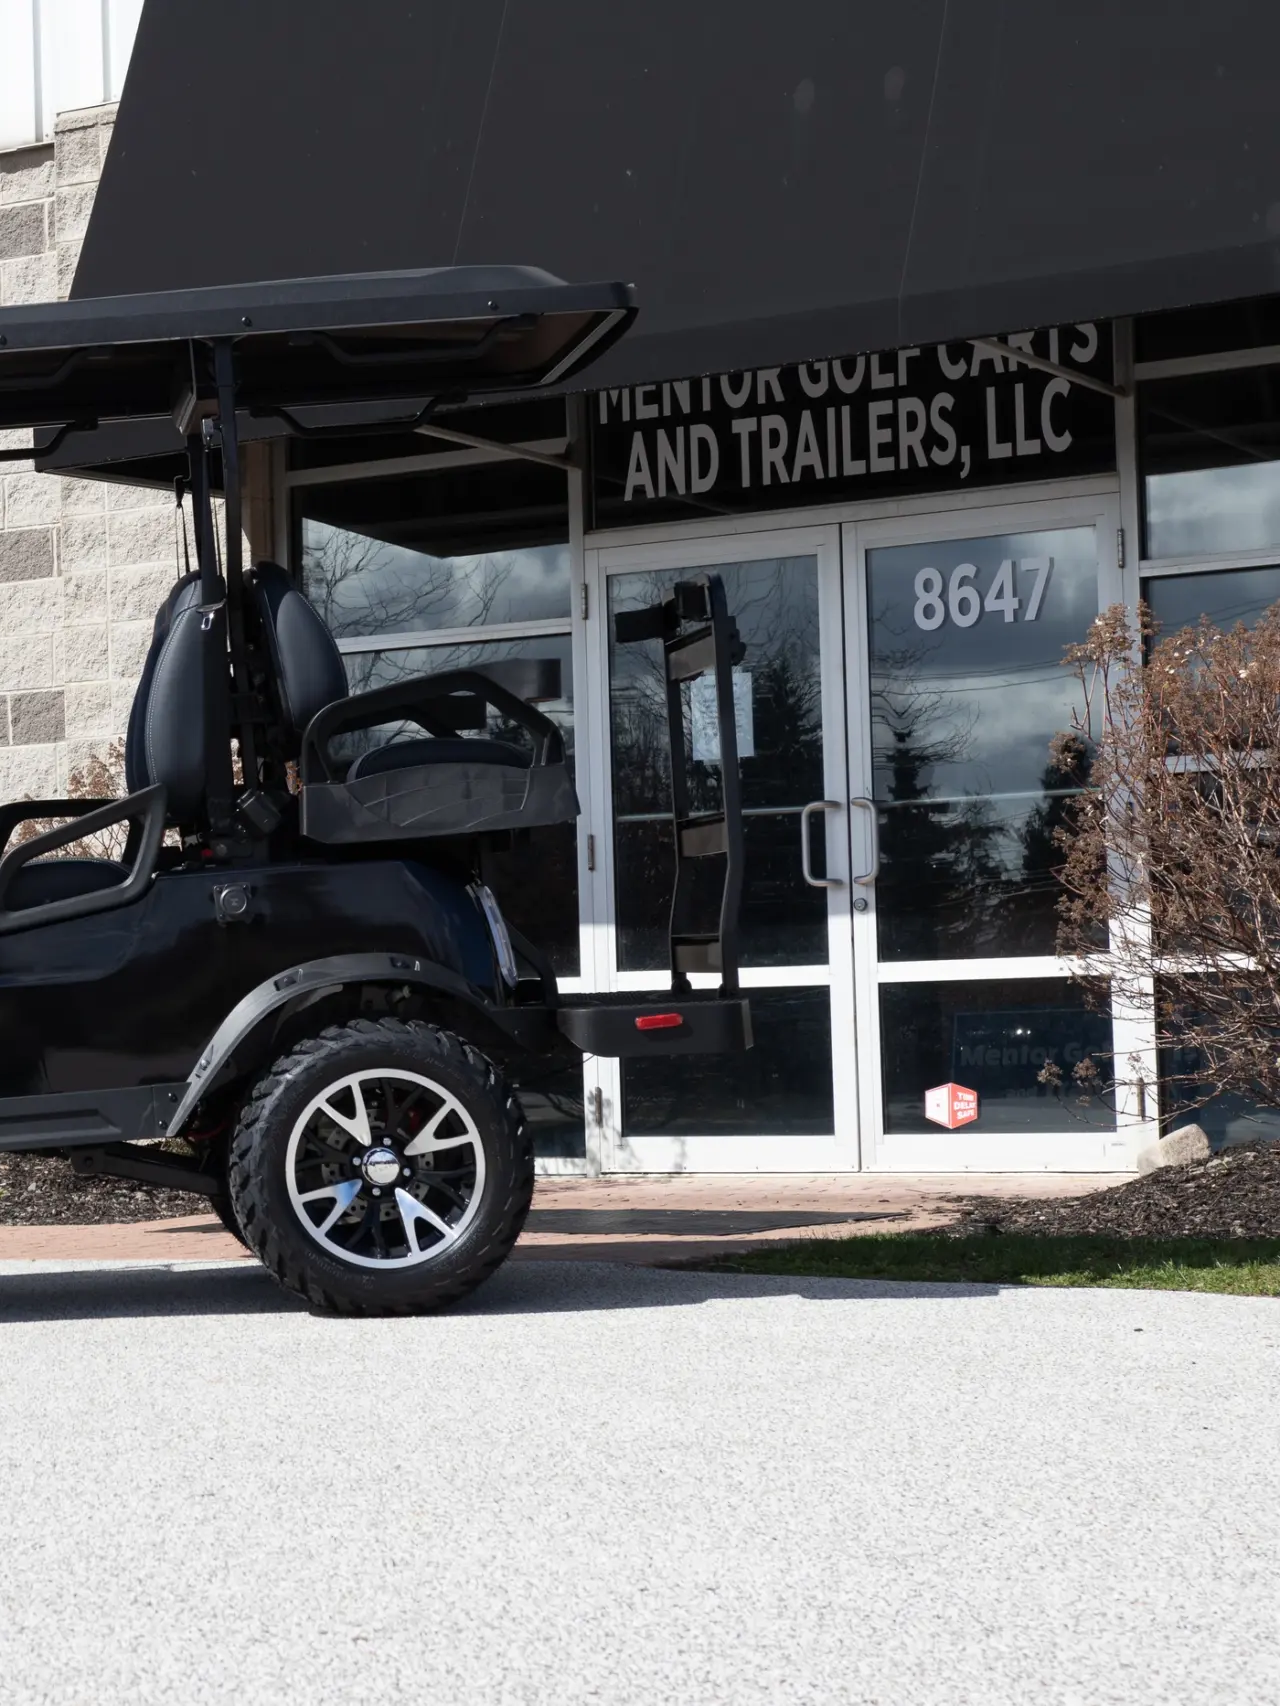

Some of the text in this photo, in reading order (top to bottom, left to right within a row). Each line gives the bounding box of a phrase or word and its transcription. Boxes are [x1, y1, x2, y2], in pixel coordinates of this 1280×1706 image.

[624, 377, 1072, 501] AND TRAILERS, LLC
[914, 557, 1051, 631] 8647
